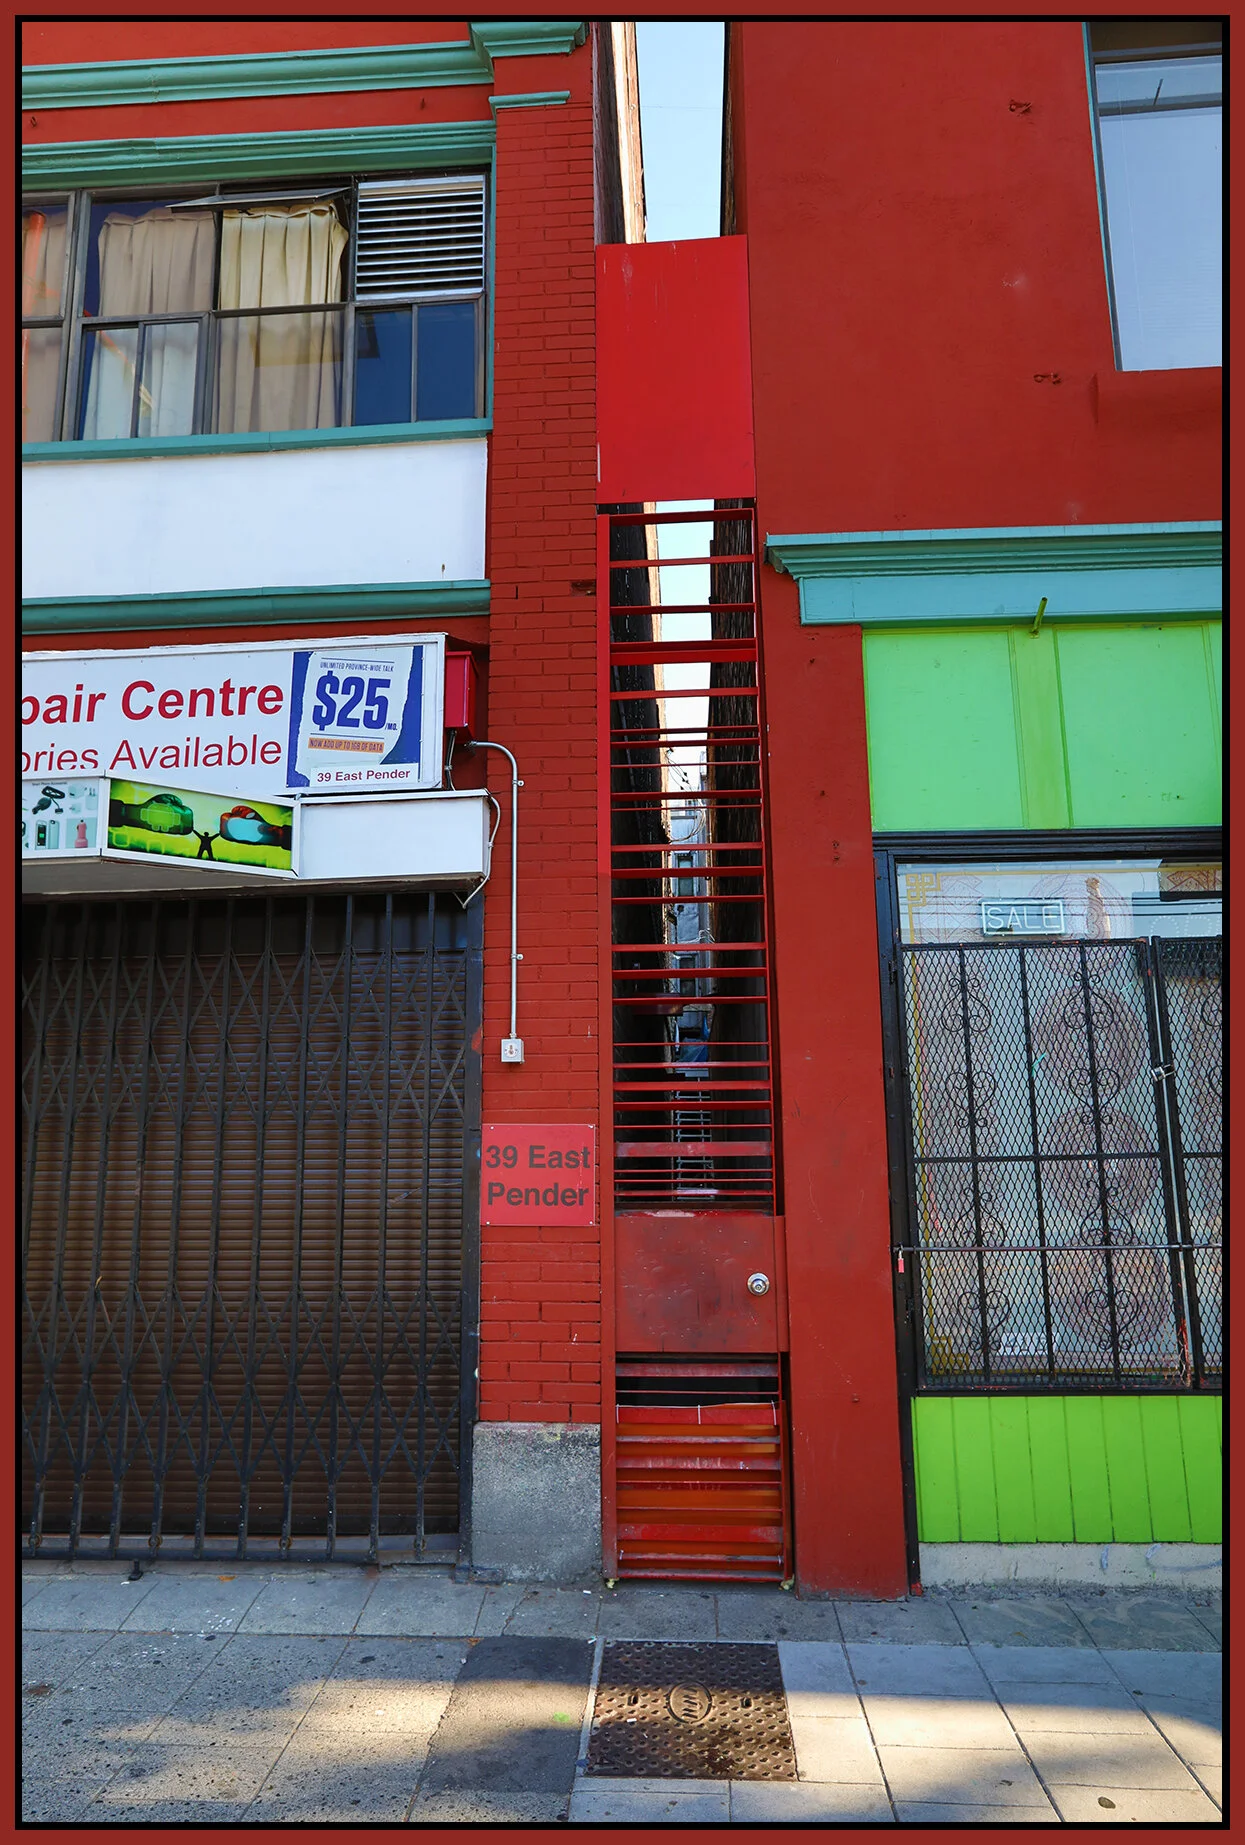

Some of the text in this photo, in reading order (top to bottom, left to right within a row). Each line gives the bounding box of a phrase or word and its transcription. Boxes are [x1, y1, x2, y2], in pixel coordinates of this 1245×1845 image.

[320, 661, 345, 670] UNLIMITED
[345, 663, 381, 672] PROVINCE-WIDE
[121, 677, 284, 720] Centre
[312, 670, 391, 731] $25
[109, 734, 282, 770] Available
[310, 739, 322, 747] NOW
[323, 740, 334, 748] ADD
[335, 741, 342, 749] UP
[344, 741, 350, 750] TO
[369, 743, 383, 751] DATA
[317, 769, 411, 782] 39 East Pender
[987, 905, 1061, 929] SALE
[485, 1145, 591, 1168] 39 East
[487, 1182, 589, 1206] Pender
